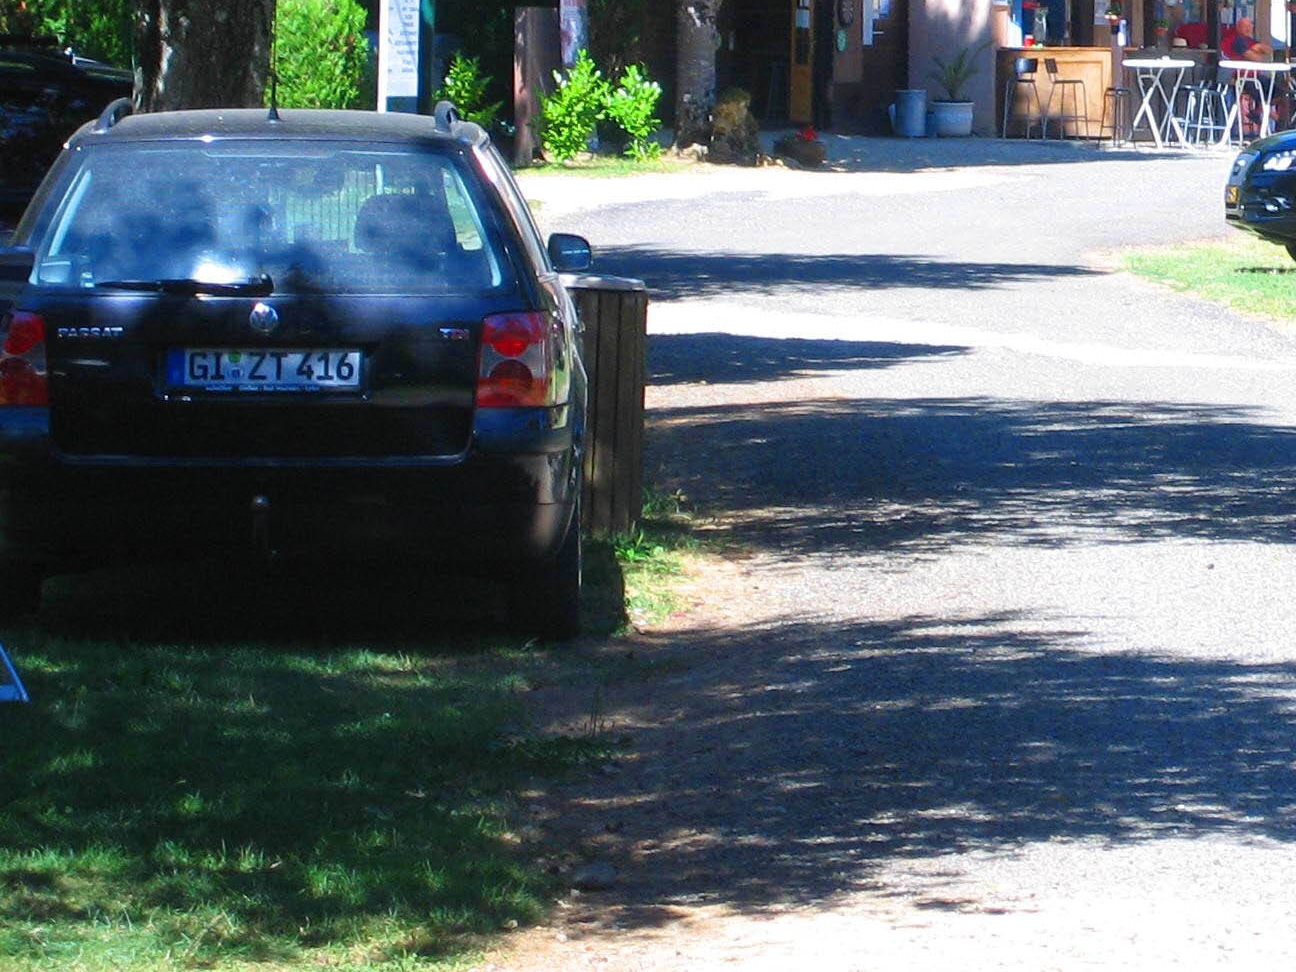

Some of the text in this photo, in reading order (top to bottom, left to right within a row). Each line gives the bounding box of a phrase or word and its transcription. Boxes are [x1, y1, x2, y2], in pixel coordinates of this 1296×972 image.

[57, 327, 124, 338] PASSAT
[189, 351, 354, 381] GI ZT 416
